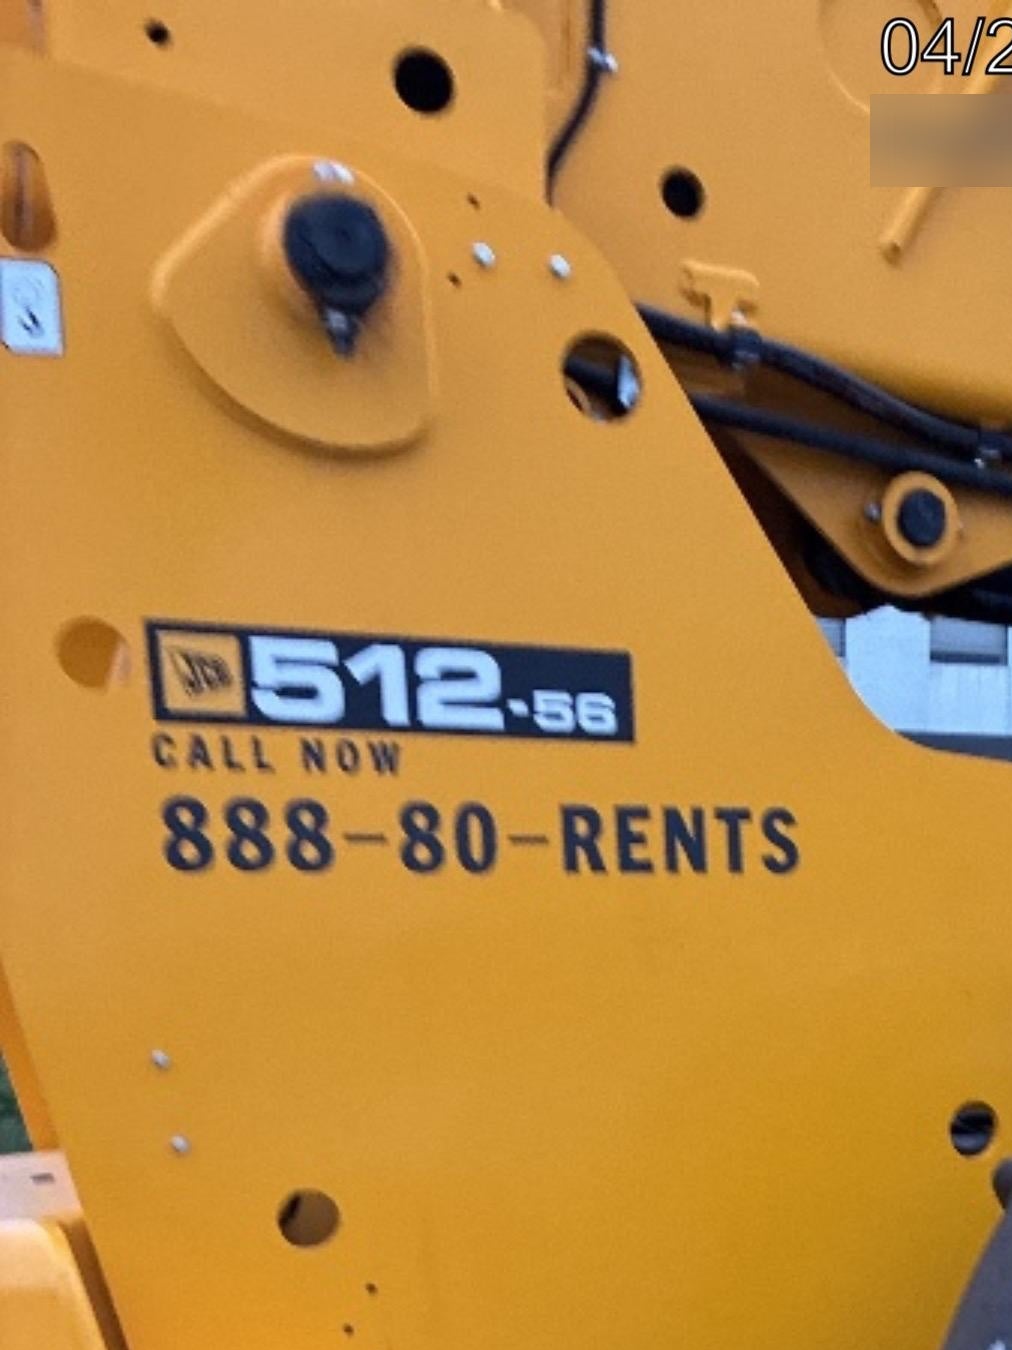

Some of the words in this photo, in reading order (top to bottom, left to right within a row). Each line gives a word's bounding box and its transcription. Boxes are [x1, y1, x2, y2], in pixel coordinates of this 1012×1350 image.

[152, 732, 276, 776] CALL
[299, 736, 402, 777] NOW
[161, 795, 800, 876] 888-80-RENTS
